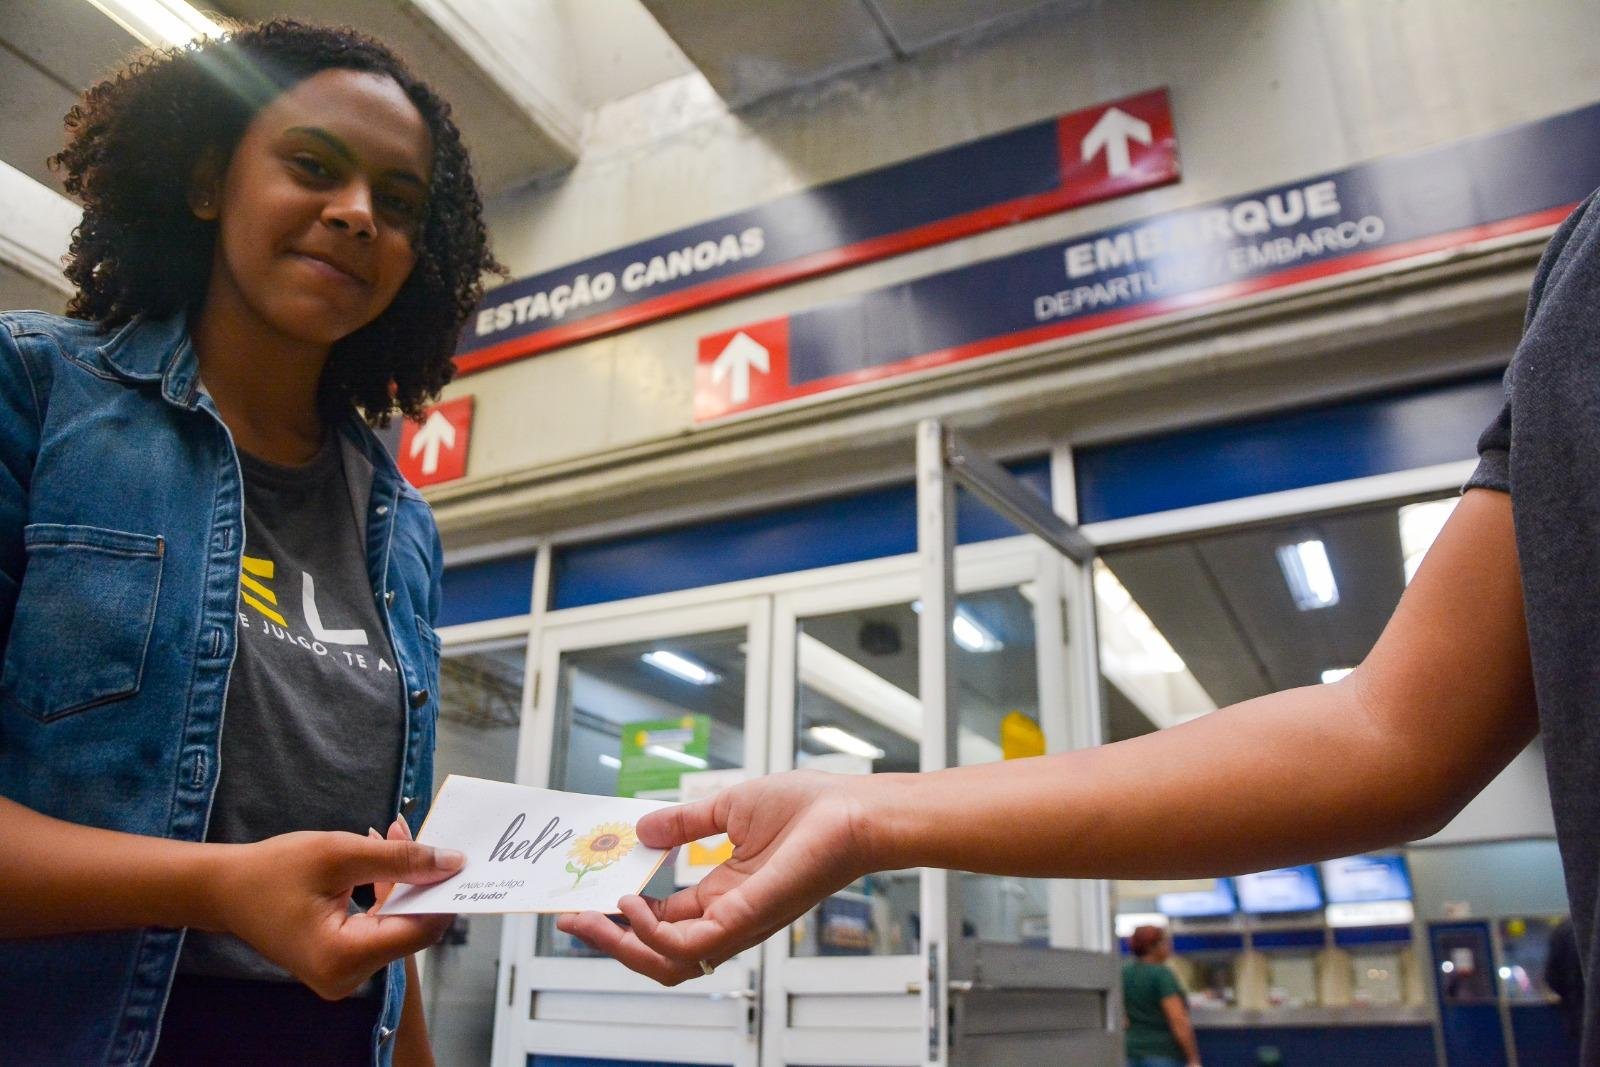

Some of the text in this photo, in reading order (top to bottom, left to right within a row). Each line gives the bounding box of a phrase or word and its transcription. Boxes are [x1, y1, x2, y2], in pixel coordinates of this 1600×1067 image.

[1065, 181, 1341, 279] EMBRQUE
[475, 227, 765, 336] ESTAÇÃO CANOAS
[1034, 257, 1205, 321] DEPARTU
[1229, 216, 1386, 272] EMBARCO
[342, 651, 368, 668] TE
[378, 657, 398, 673] A
[488, 812, 575, 865] help
[468, 891, 507, 901] Ajudo!
